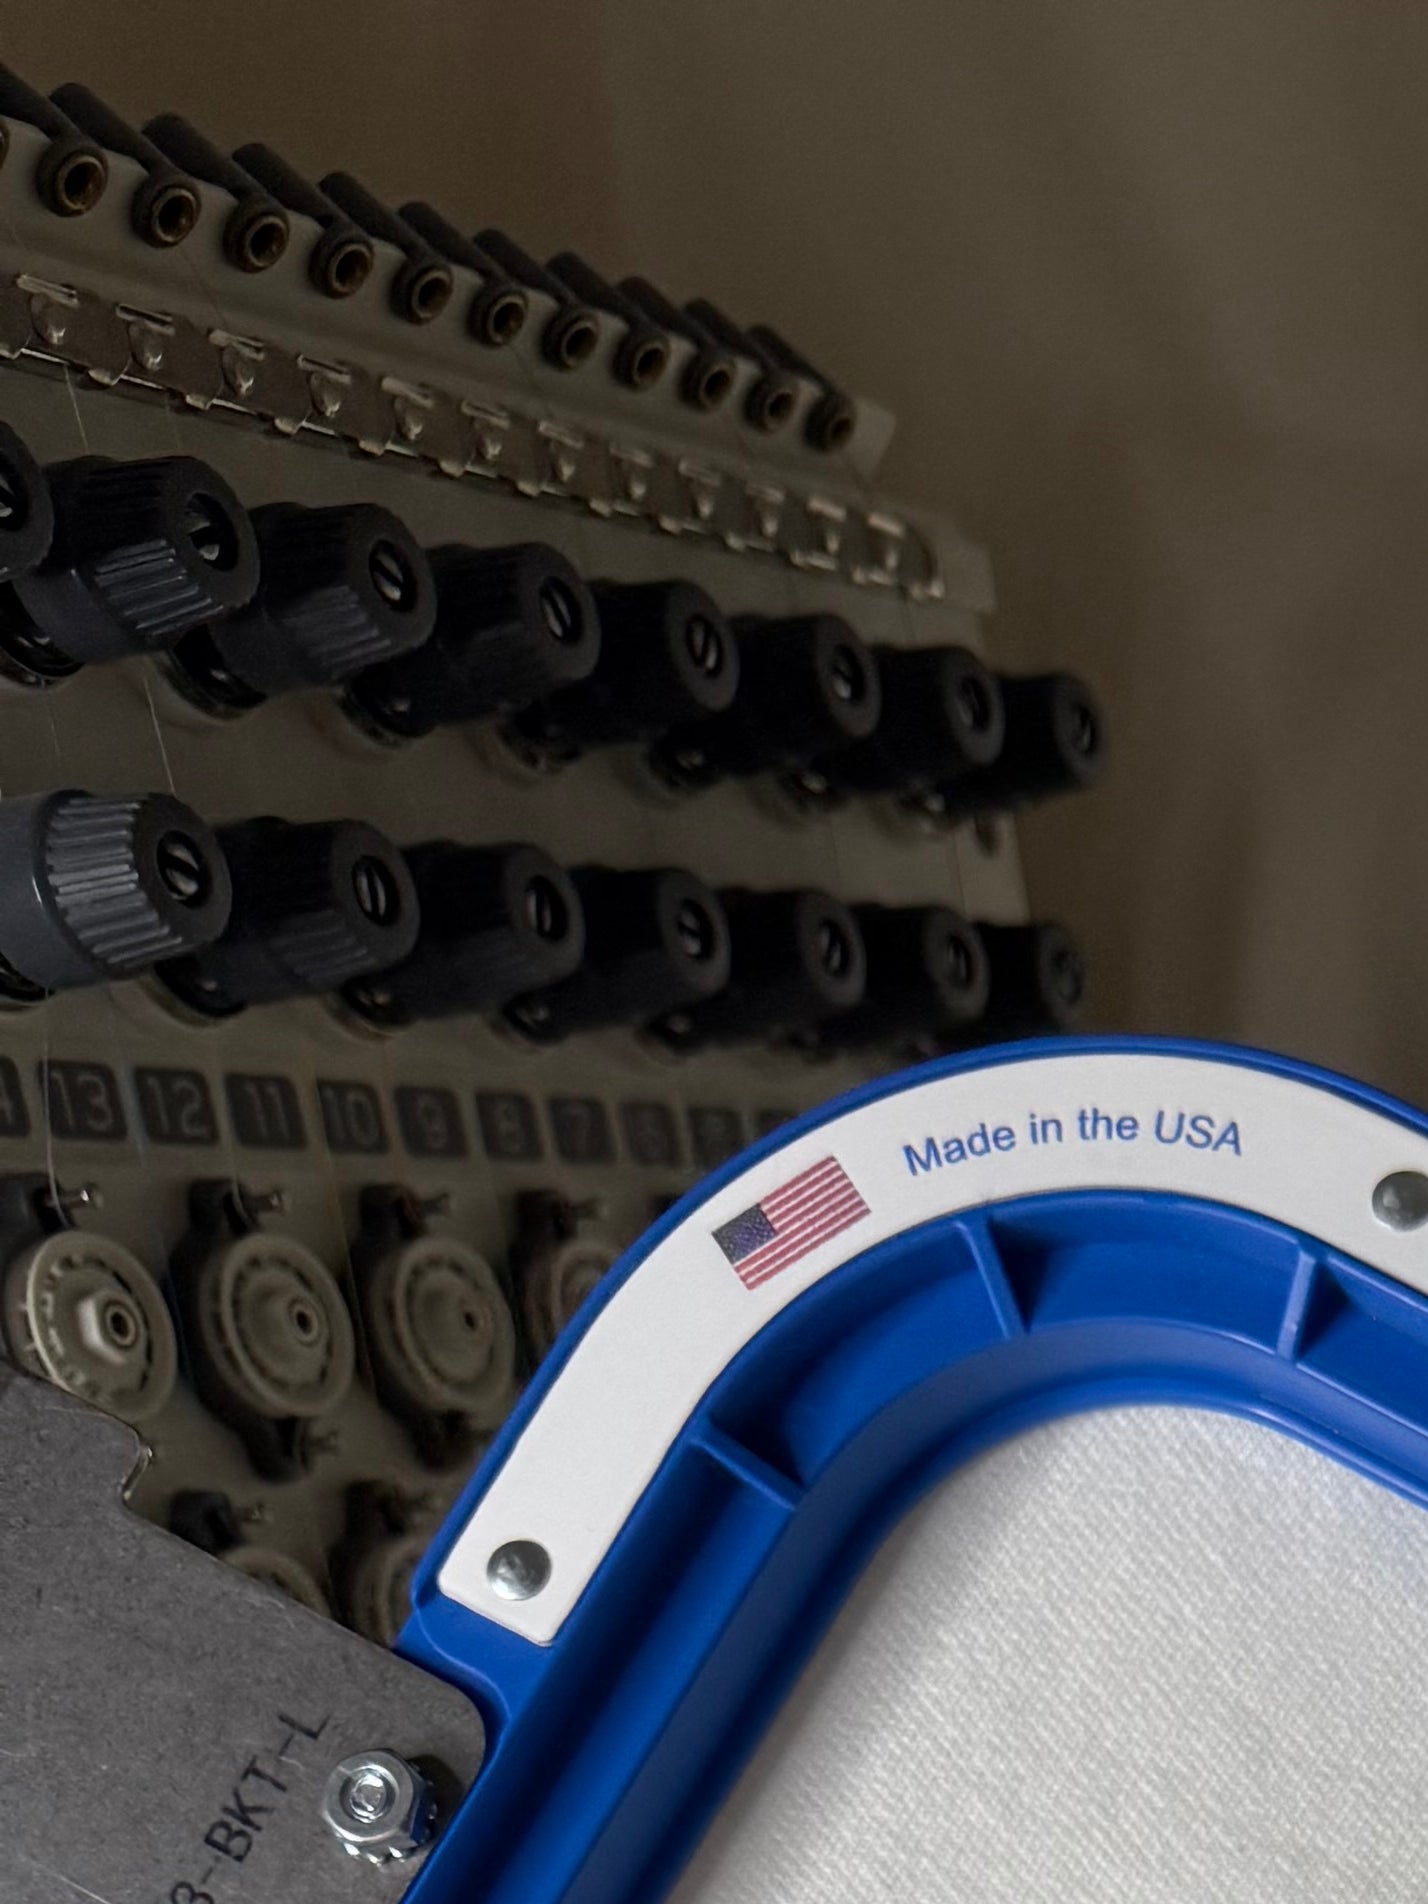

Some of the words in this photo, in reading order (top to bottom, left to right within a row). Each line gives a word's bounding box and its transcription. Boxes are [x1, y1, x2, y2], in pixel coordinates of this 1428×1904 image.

[51, 1071, 114, 1132] 13
[146, 1075, 209, 1138] 12
[243, 1079, 291, 1141] 11
[321, 1086, 380, 1147] 10
[903, 1123, 1016, 1176] Made
[1029, 1113, 1063, 1145] in
[1079, 1107, 1139, 1141] the
[1154, 1109, 1243, 1157] USA
